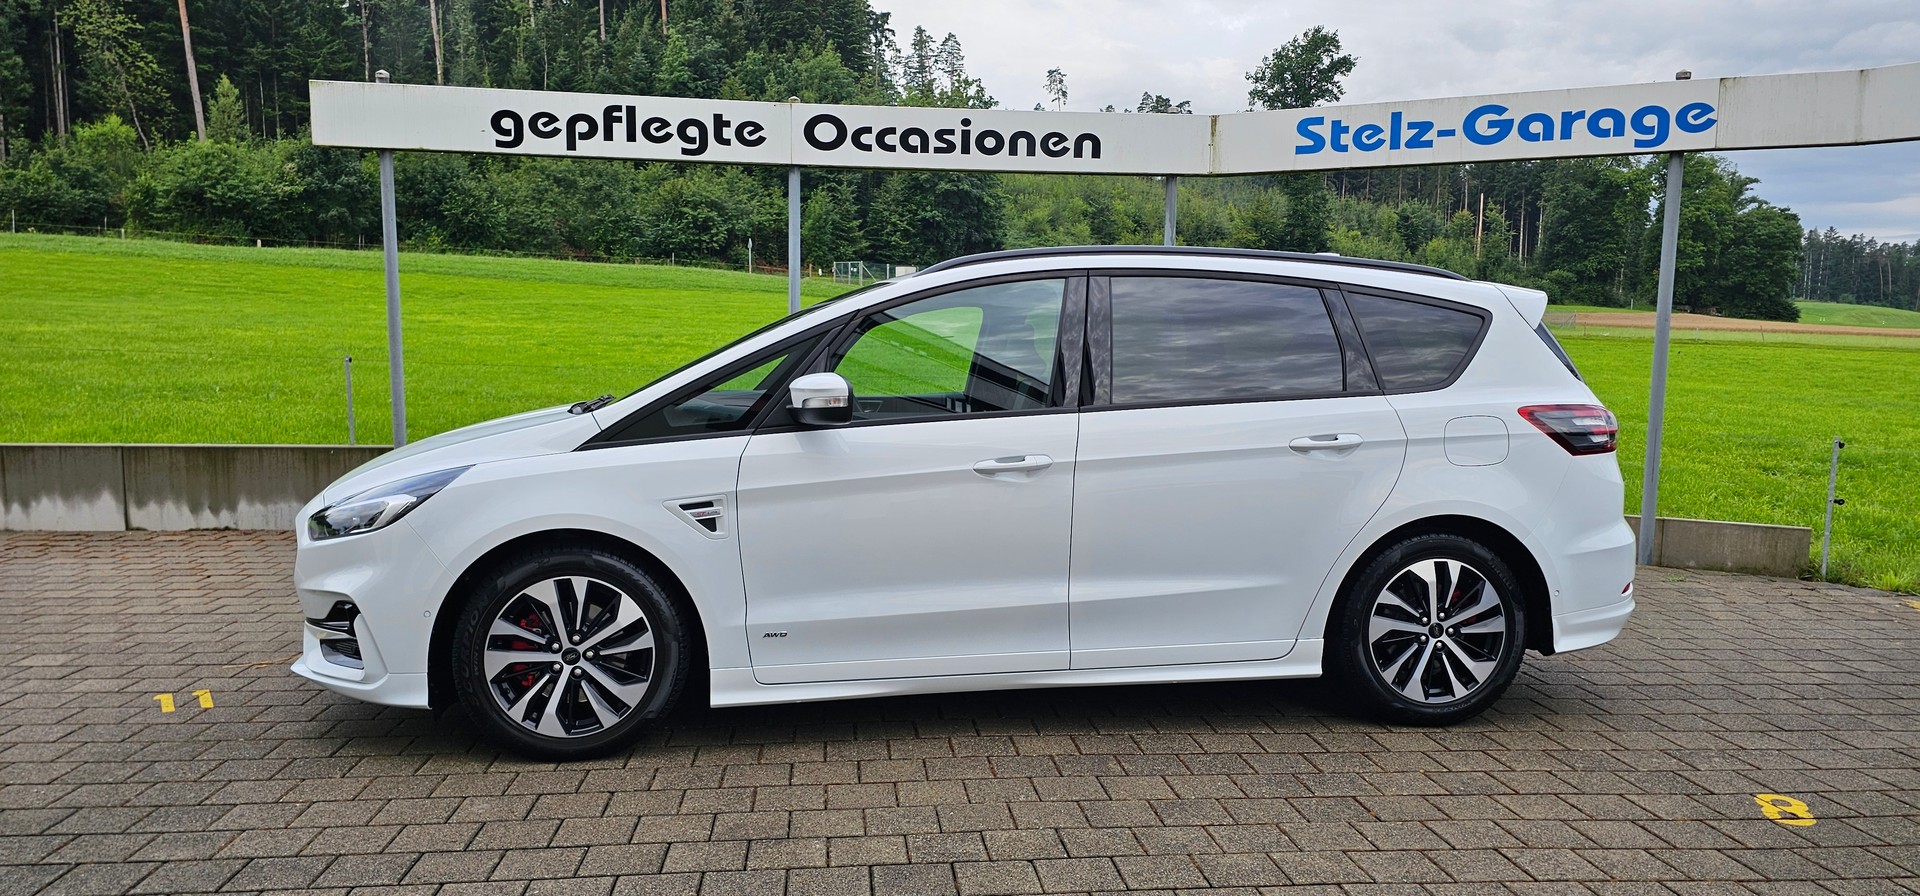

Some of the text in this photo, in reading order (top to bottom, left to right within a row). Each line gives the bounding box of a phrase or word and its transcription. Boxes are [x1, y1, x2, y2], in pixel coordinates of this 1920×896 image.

[491, 105, 1102, 159] gepflegte Occasionen
[1294, 102, 1717, 155] Stelz-Garage
[762, 631, 788, 639] AWD
[153, 689, 214, 713] 11
[1754, 794, 1817, 827] 8
